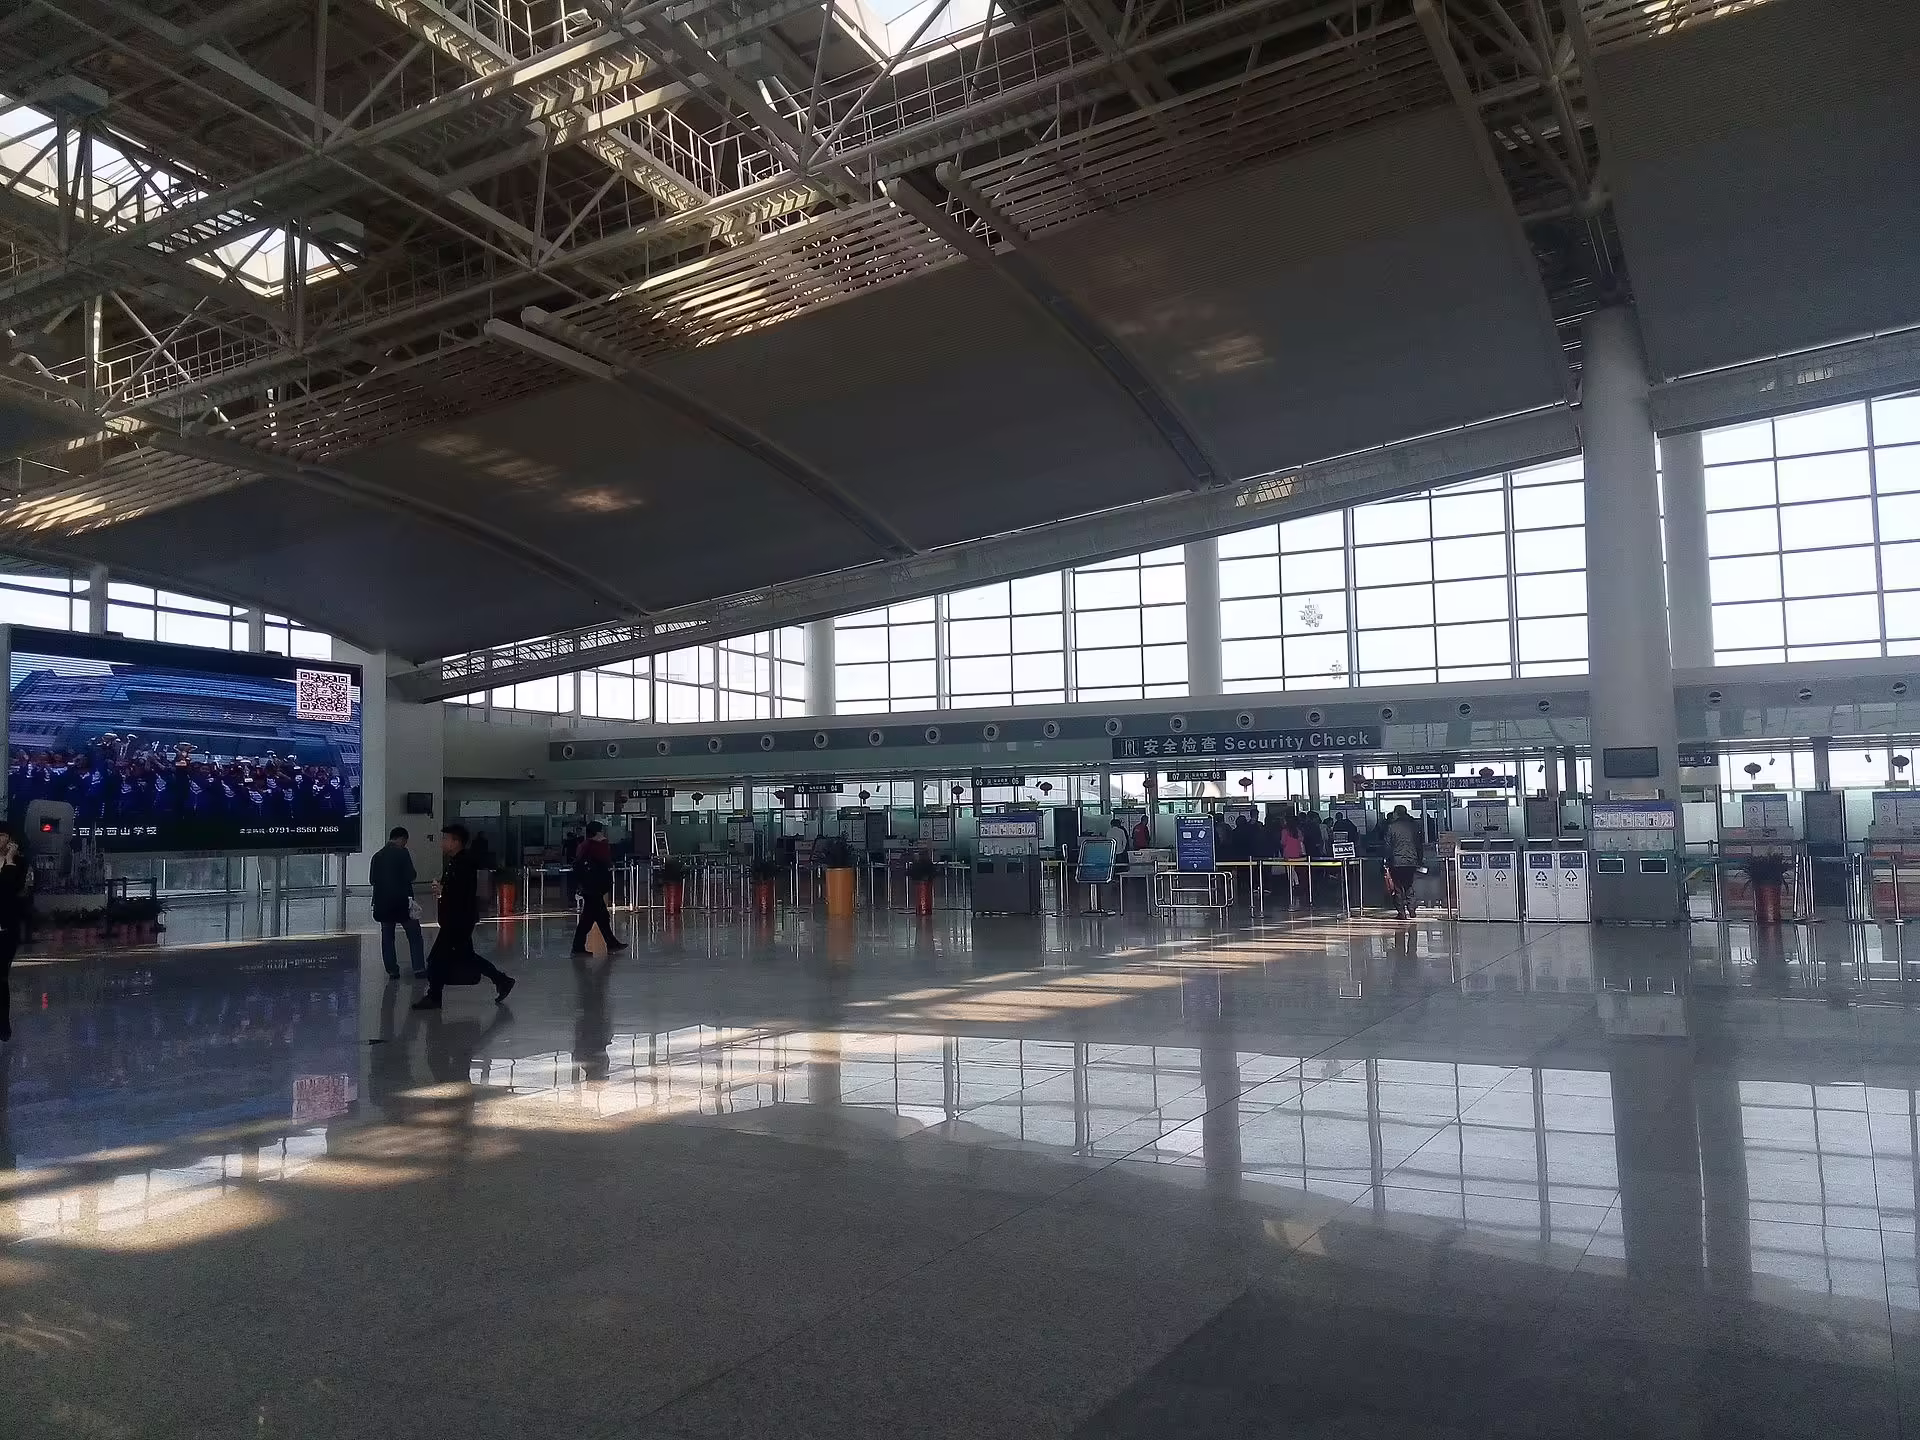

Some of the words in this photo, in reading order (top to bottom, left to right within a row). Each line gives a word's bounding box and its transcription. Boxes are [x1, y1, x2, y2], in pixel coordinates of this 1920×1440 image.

[1143, 736, 1217, 755] 安全检查
[1223, 734, 1305, 751] Security
[1309, 731, 1369, 747] Check
[1702, 755, 1712, 764] 12
[1392, 765, 1402, 774] 09
[1172, 772, 1180, 781] 07
[975, 778, 983, 786] 05
